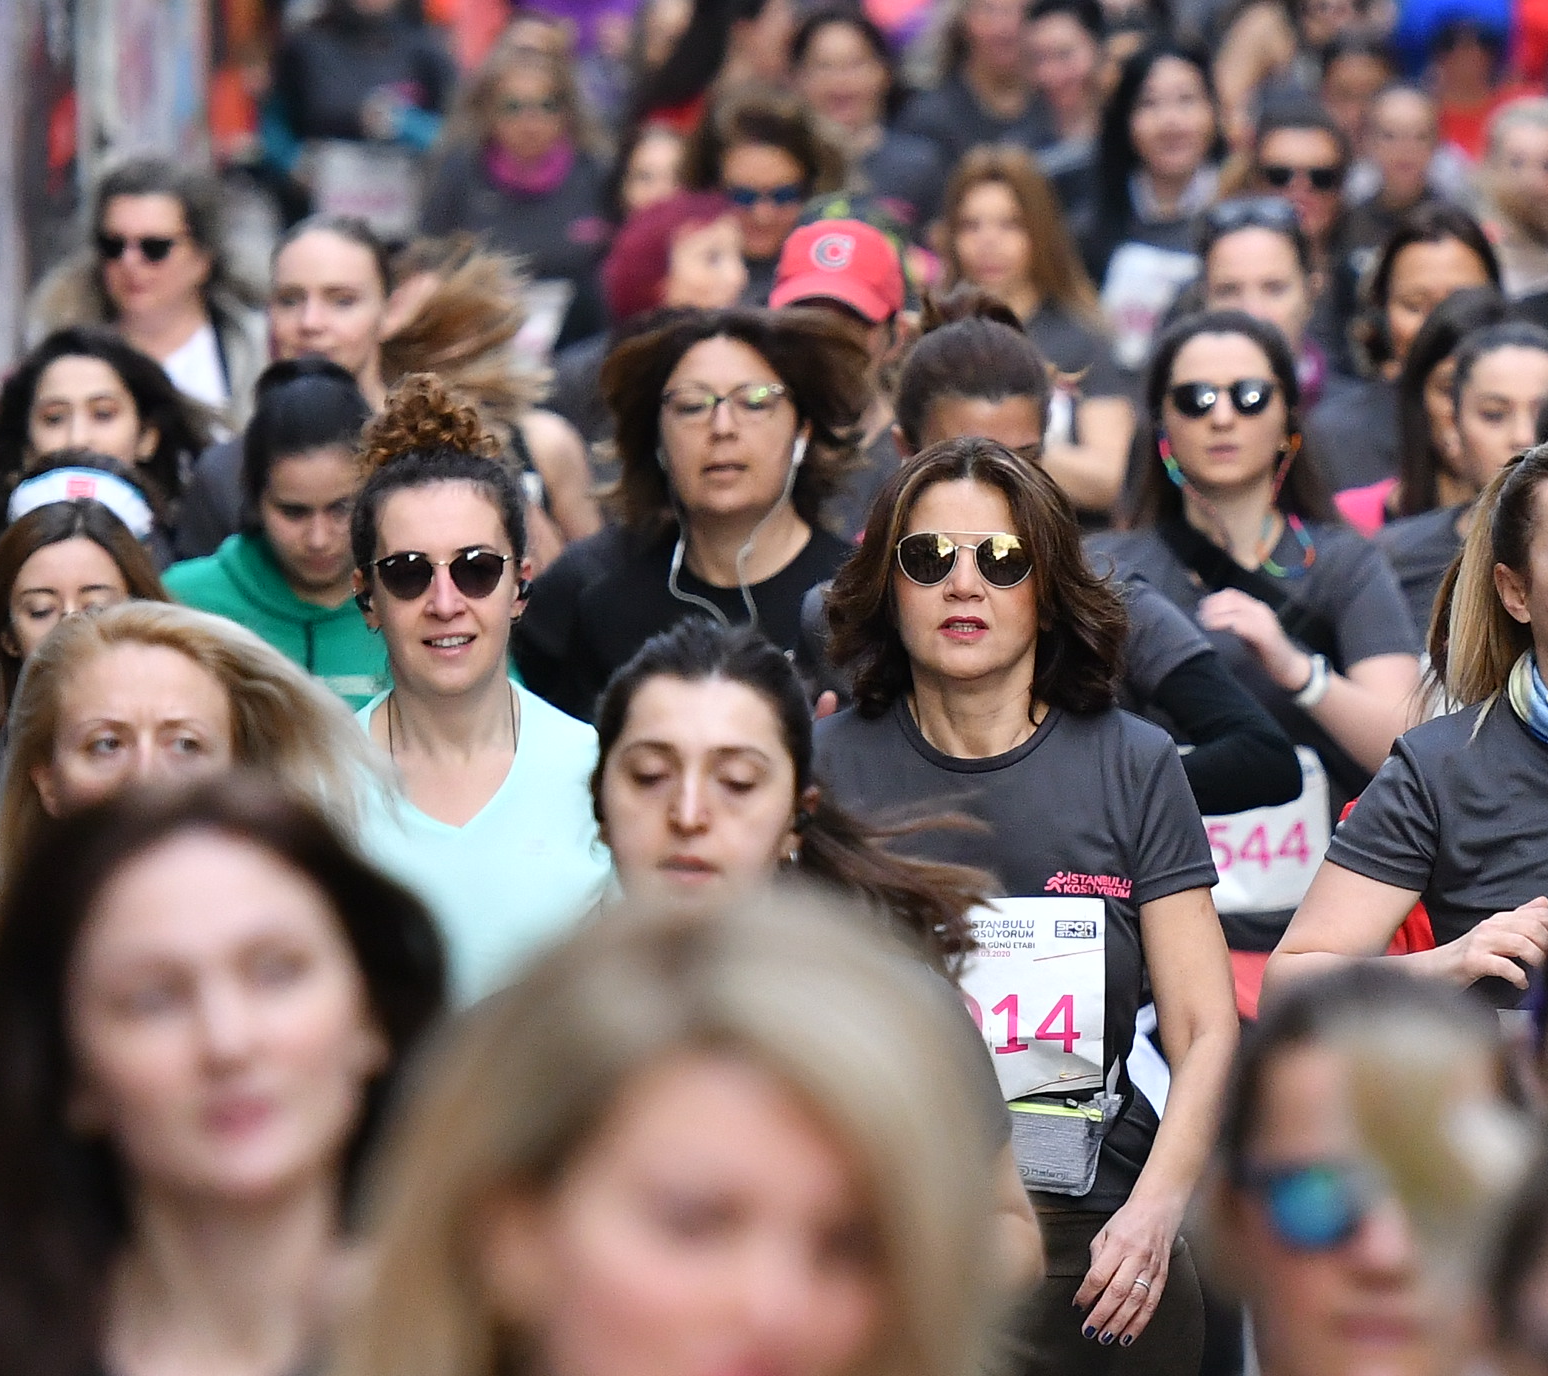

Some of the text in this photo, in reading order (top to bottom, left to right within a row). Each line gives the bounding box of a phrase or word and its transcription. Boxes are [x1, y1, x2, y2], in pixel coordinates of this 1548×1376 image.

[1208, 821, 1311, 873] 544
[971, 919, 1035, 929] STANBULU
[1056, 921, 1095, 932] SPOR
[972, 929, 1034, 939] OSUYORUM
[963, 991, 1081, 1055] 14
